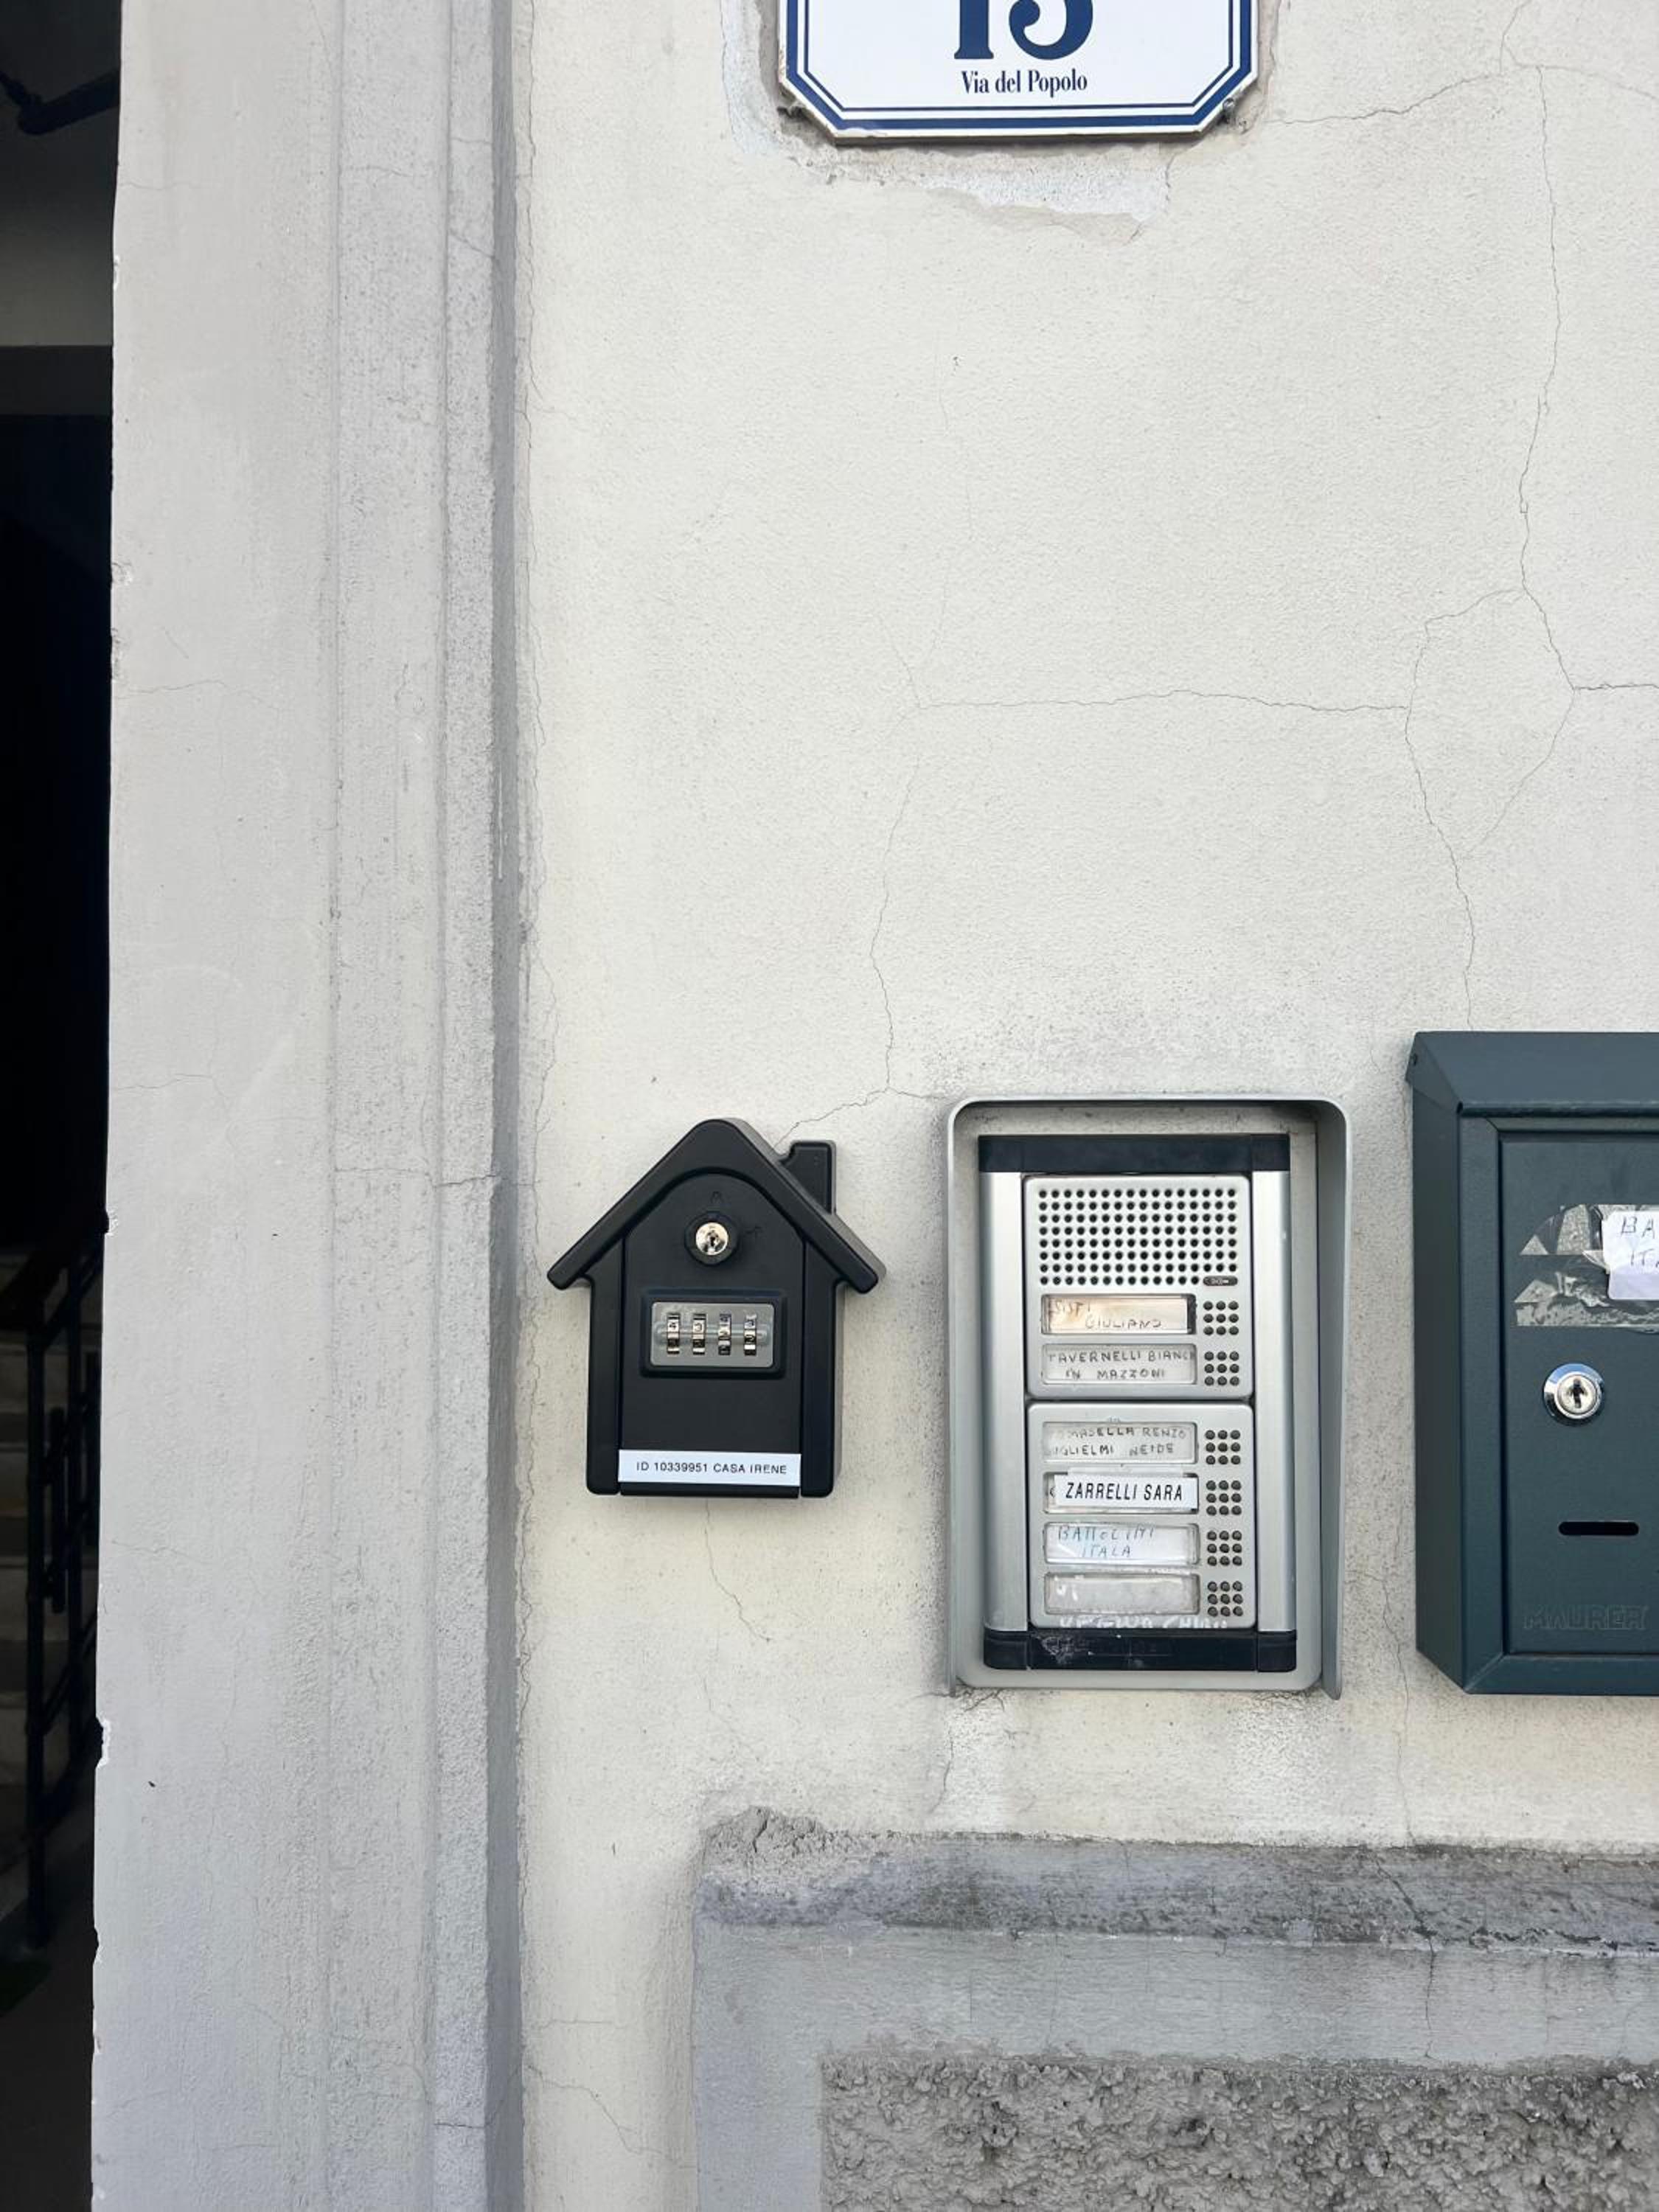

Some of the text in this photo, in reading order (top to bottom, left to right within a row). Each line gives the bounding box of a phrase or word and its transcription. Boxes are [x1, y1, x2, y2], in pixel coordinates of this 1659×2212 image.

[961, 68, 1088, 98] Via del Popolo
[1630, 1248, 1659, 1267] IT
[1048, 1351, 1141, 1363] TAVERNELLI
[1097, 1368, 1165, 1379] MAZZONI
[1143, 1427, 1187, 1439] RENZO
[636, 1461, 787, 1475] ID 10339951 CASA IRENE
[1065, 1482, 1183, 1501] ZARRELLI SARA
